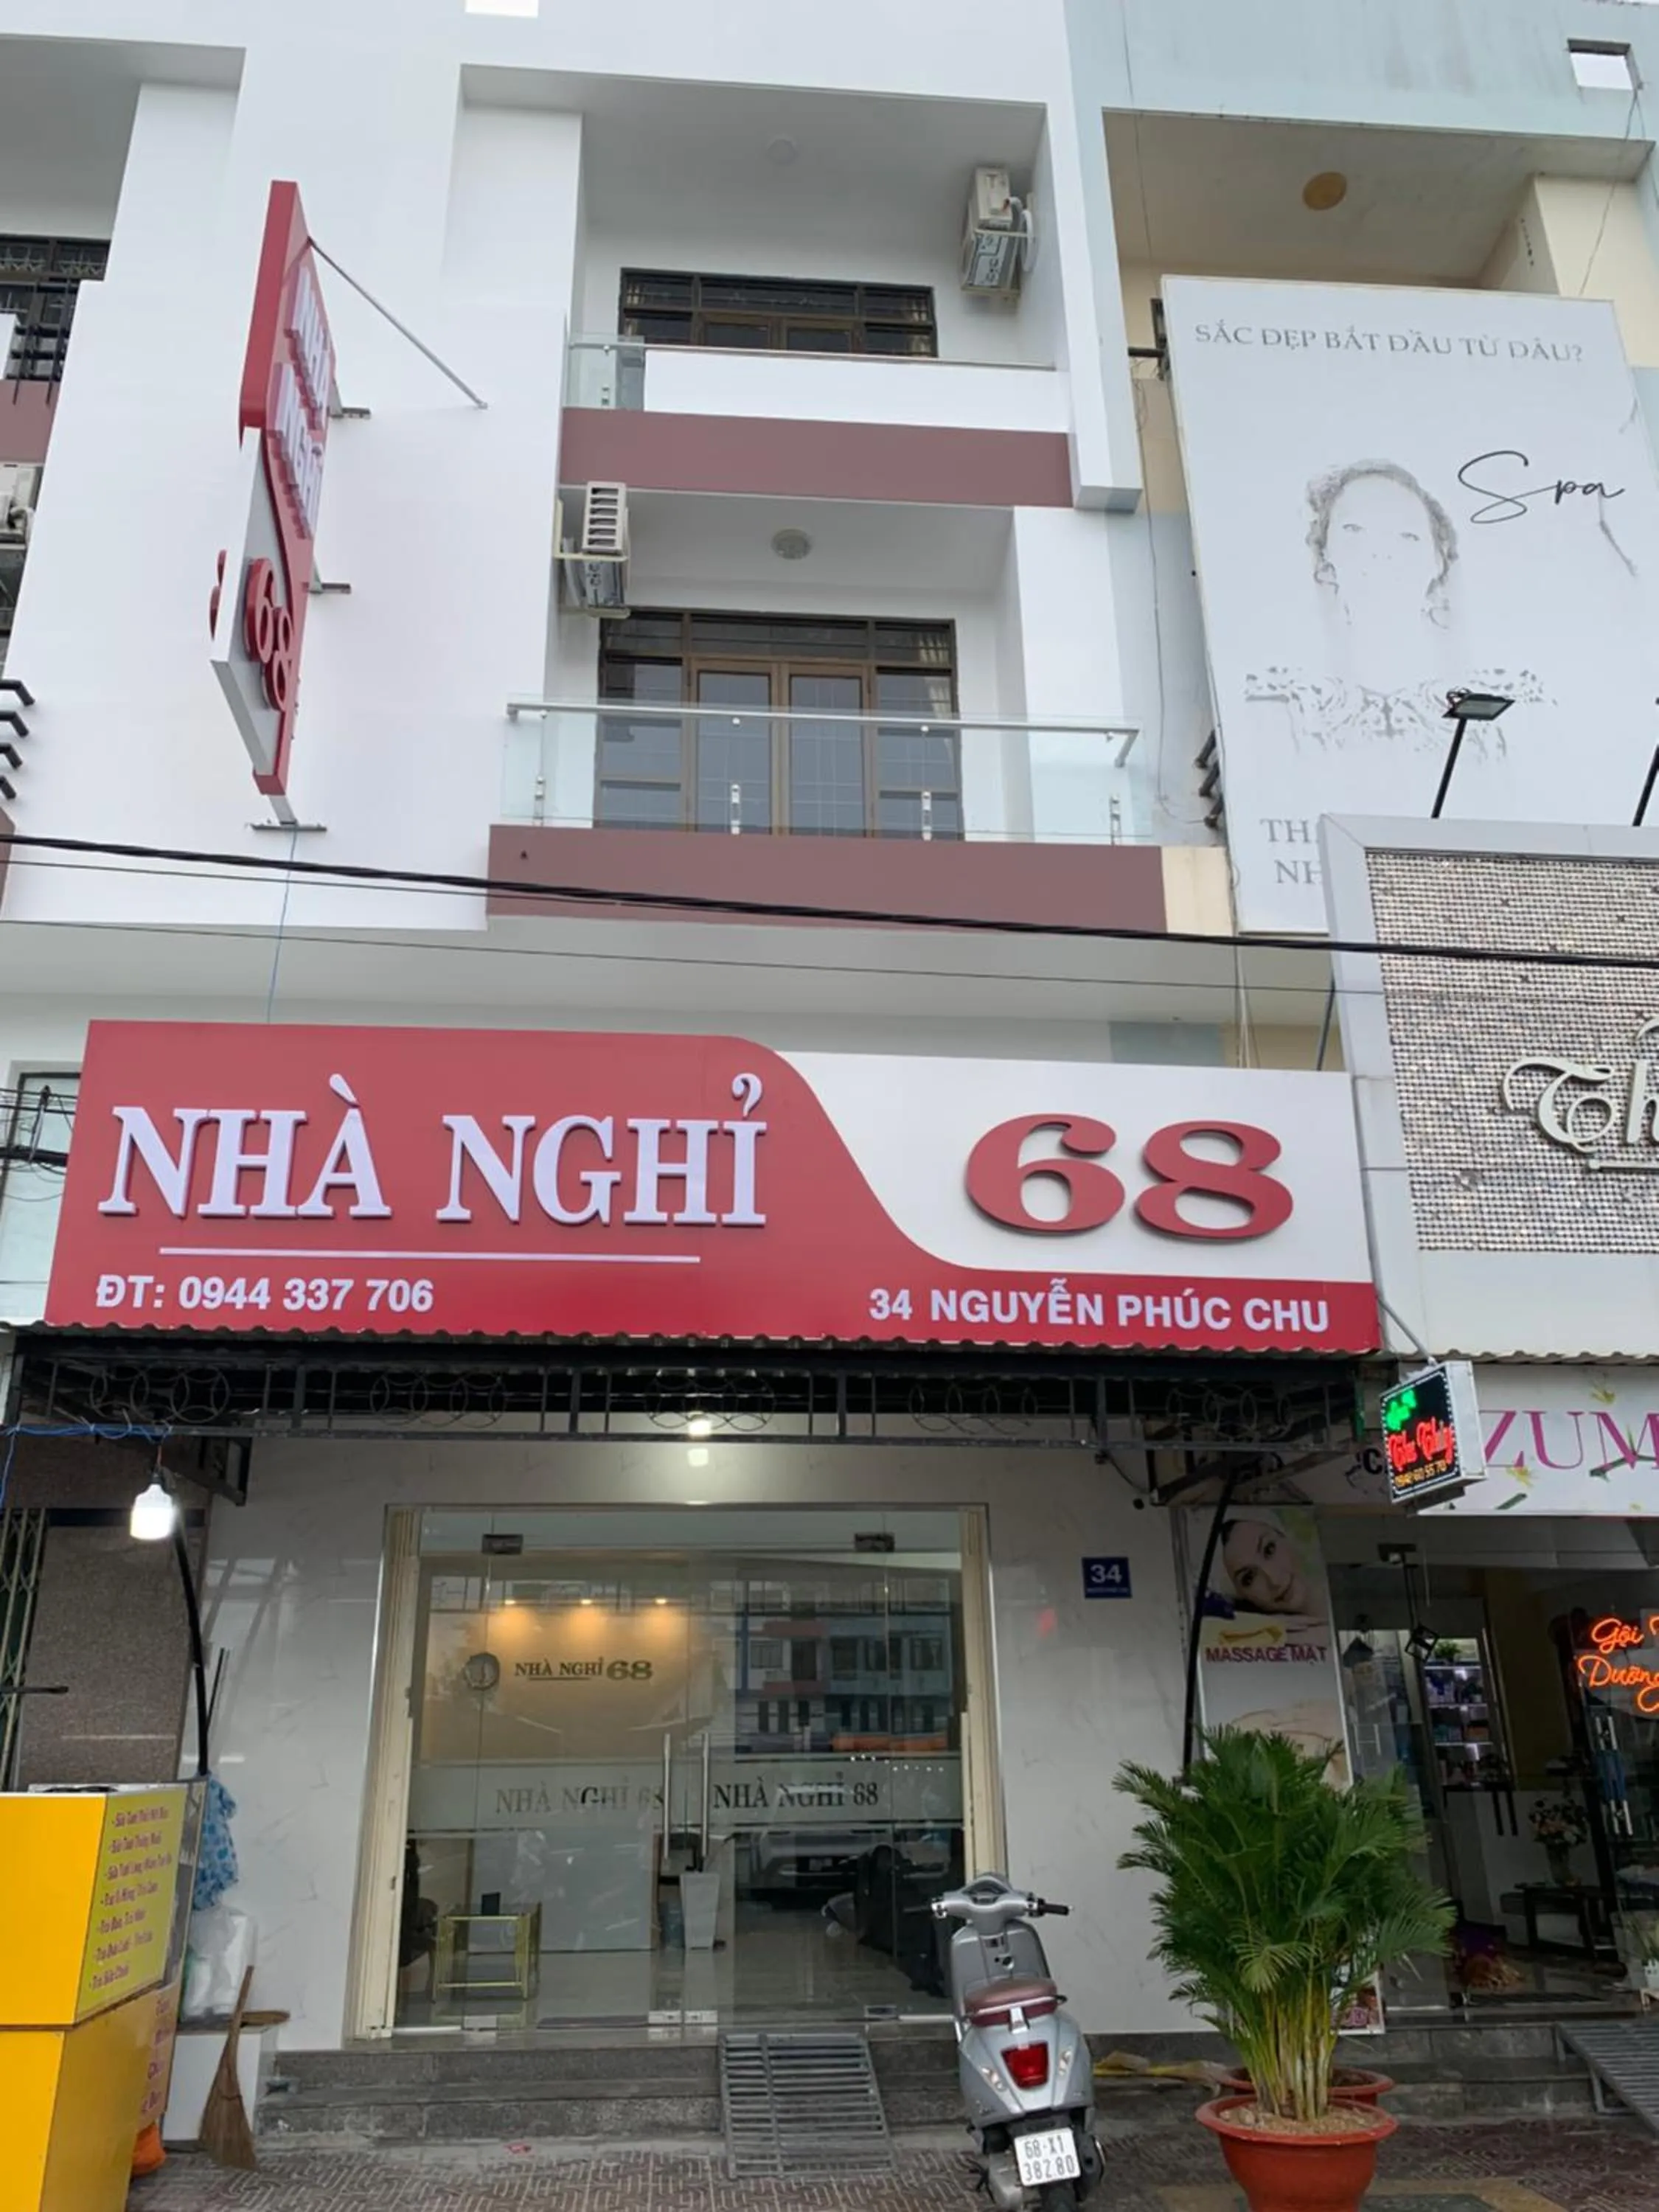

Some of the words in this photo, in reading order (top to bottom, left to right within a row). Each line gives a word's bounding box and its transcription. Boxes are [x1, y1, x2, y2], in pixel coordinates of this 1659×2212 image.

[1458, 450, 1625, 524] Spa
[246, 557, 295, 713] 68
[1259, 818, 1318, 844] TH
[97, 1073, 392, 1220] NHÀ
[436, 1073, 768, 1226] NGHỈ
[965, 1112, 1295, 1241] 68
[95, 1274, 164, 1308] ĐT:
[178, 1276, 271, 1310] 0944
[282, 1278, 355, 1312] 337
[366, 1279, 434, 1314] 706
[869, 1287, 913, 1321] 34
[931, 1277, 1104, 1327] NGUYỄN
[1117, 1288, 1231, 1330] PHÚC
[1243, 1298, 1329, 1333] CHU
[1091, 1564, 1121, 1584] 34
[1592, 1618, 1645, 1653] Gội
[515, 1658, 552, 1677] NHÀ
[606, 1660, 654, 1681] 68
[1206, 1646, 1288, 1663] MASSAGE
[495, 1780, 552, 1814] NHÀ
[713, 1774, 769, 1809] NHÀ
[852, 1781, 879, 1806] 68
